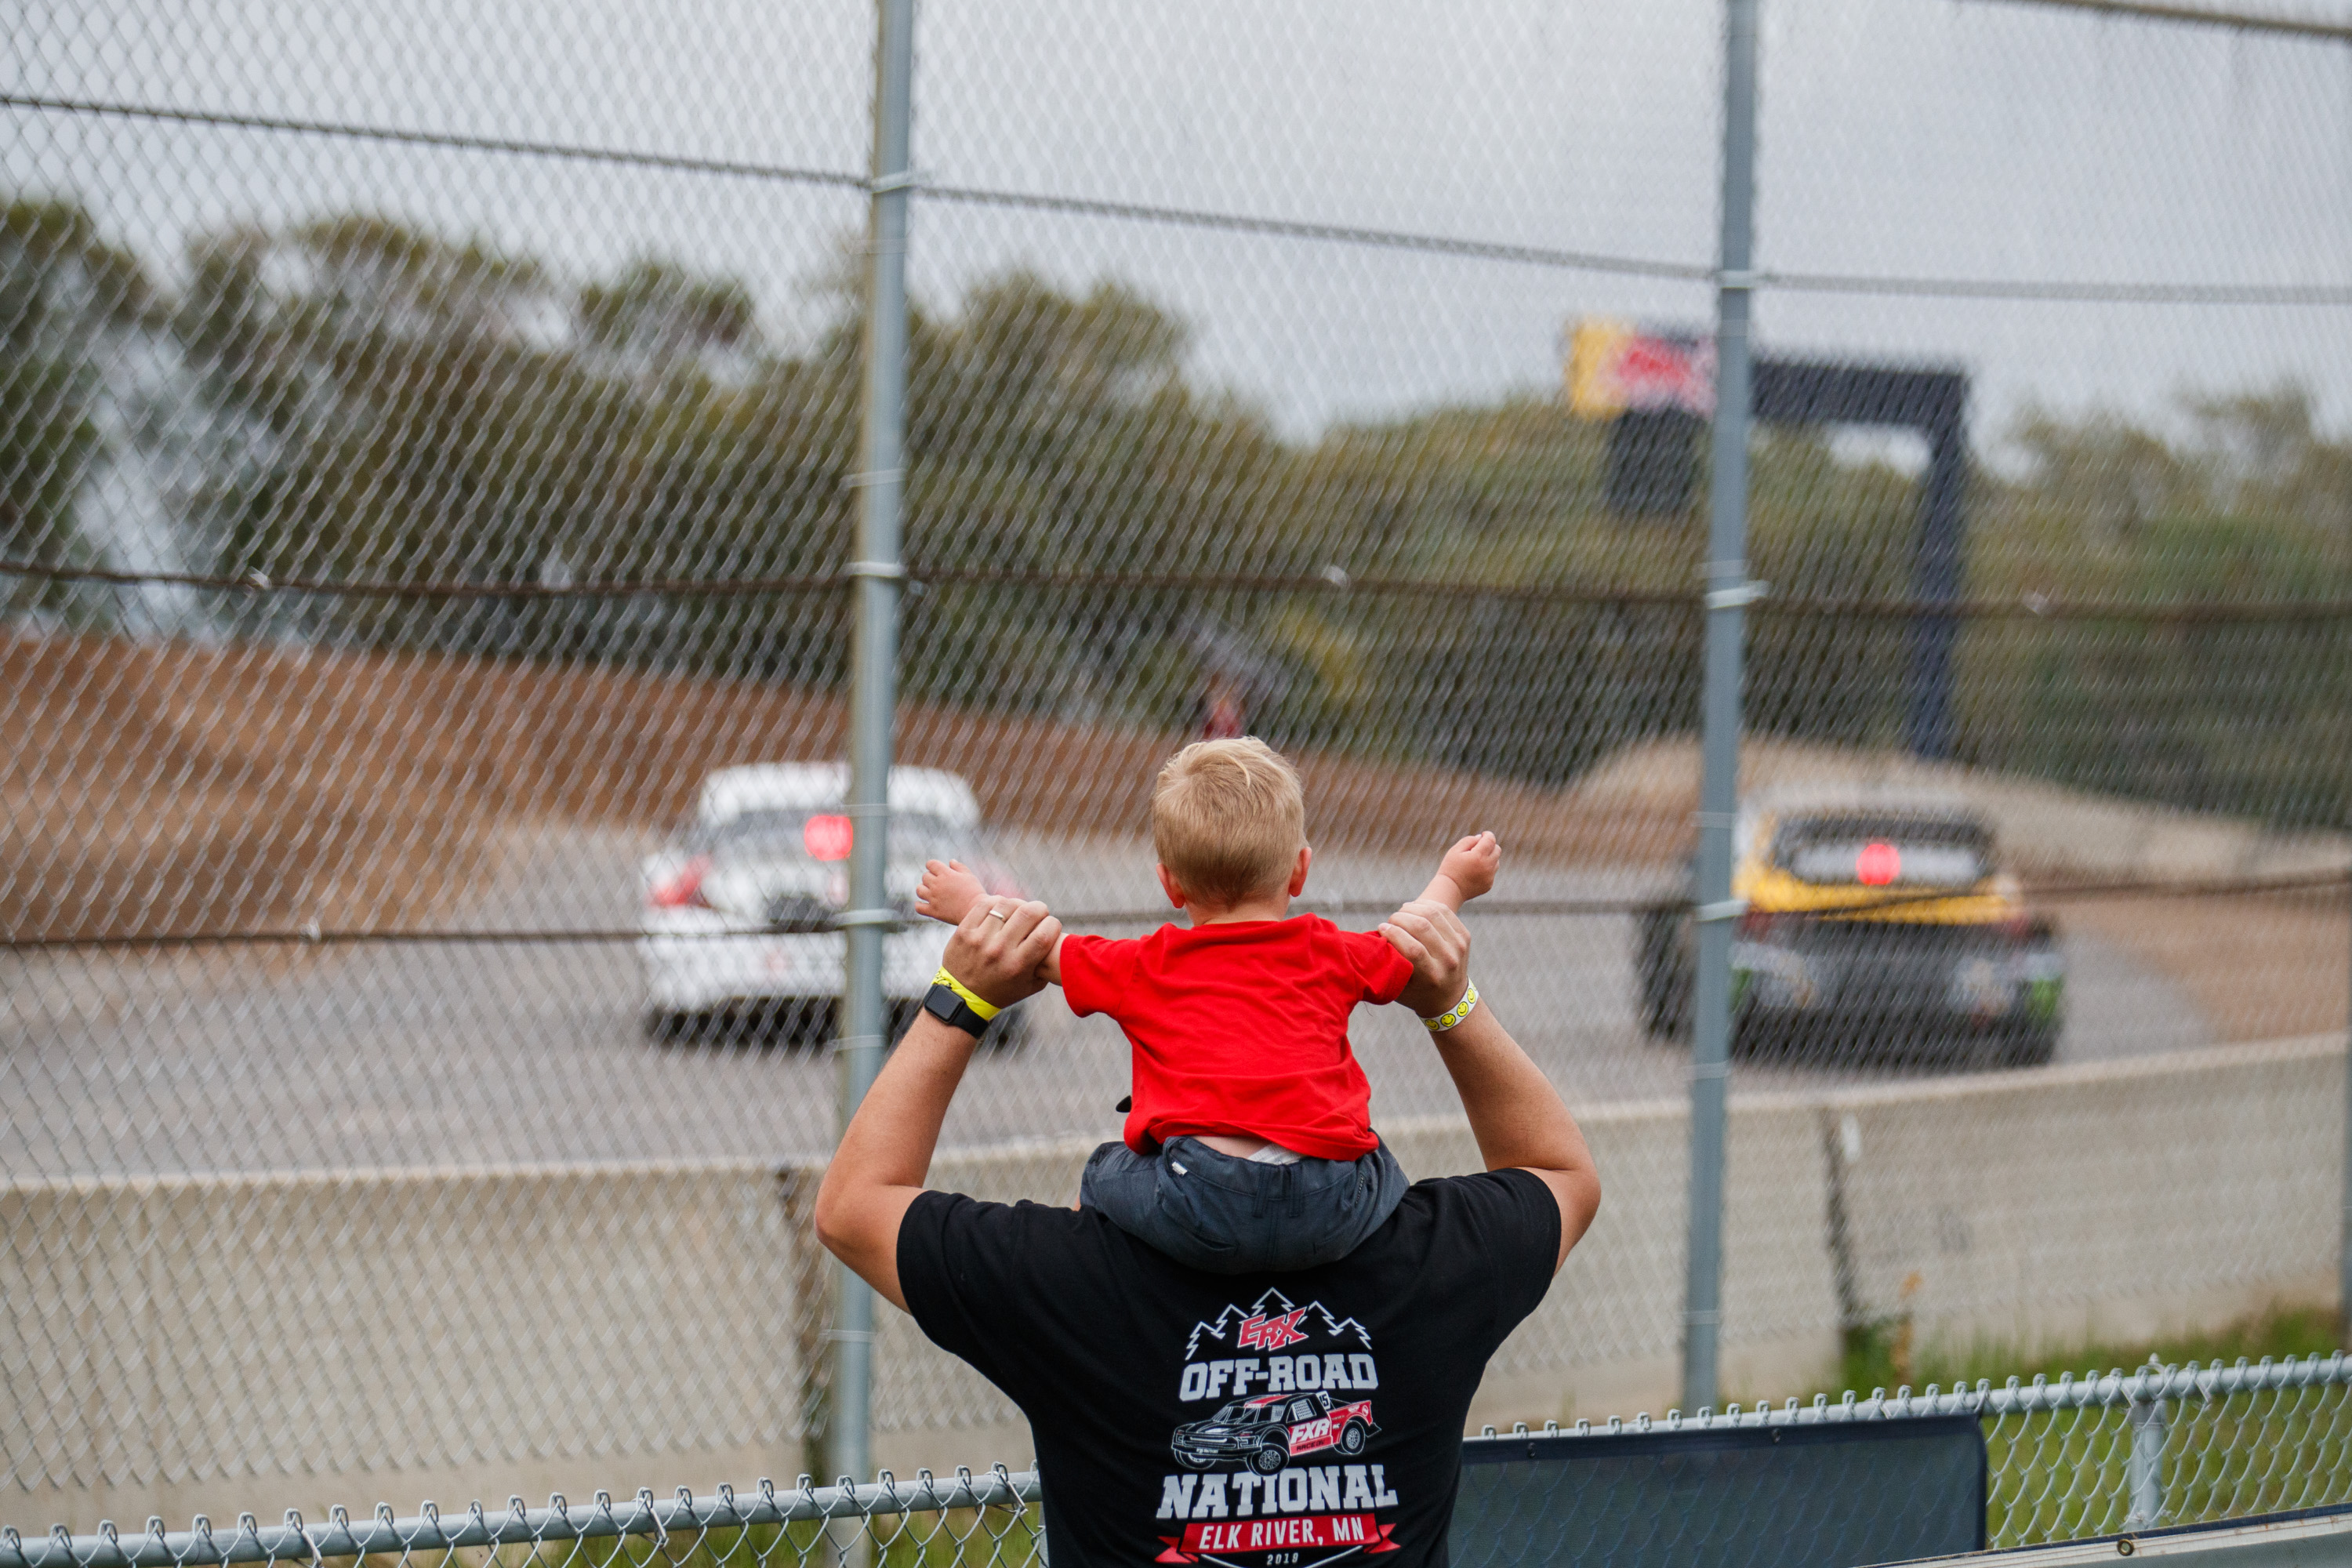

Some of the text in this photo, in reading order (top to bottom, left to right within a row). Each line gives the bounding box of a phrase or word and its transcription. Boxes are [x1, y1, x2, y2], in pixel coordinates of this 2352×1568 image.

[1237, 1306, 1309, 1351] ERX
[1179, 1354, 1379, 1402] OFF-ROAD
[1290, 1418, 1330, 1444] FXR
[1156, 1465, 1399, 1519] NATIONAL
[1199, 1516, 1365, 1550] ELK RIVER, MN
